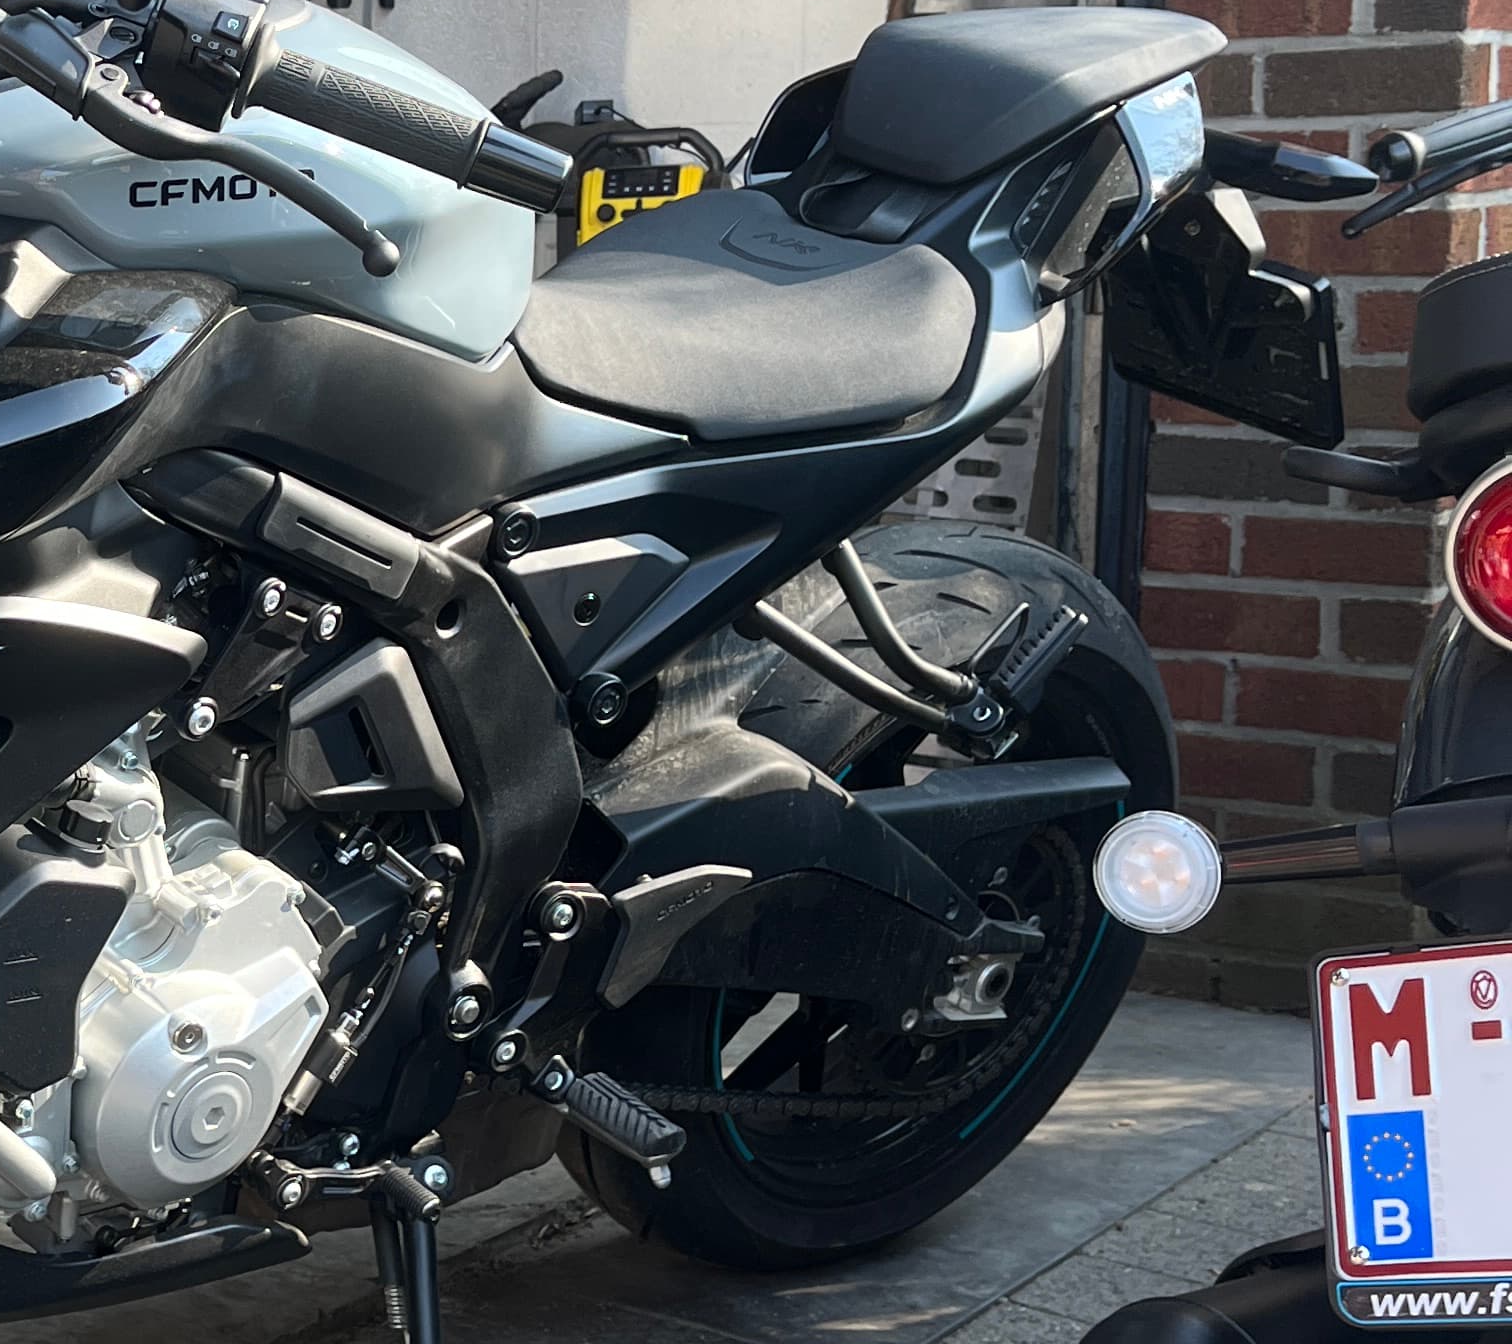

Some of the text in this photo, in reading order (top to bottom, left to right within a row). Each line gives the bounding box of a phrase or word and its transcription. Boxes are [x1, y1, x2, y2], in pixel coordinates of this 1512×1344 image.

[129, 169, 315, 208] CFMO
[1373, 1198, 1412, 1246] B
[1370, 1282, 1512, 1317] www.f
